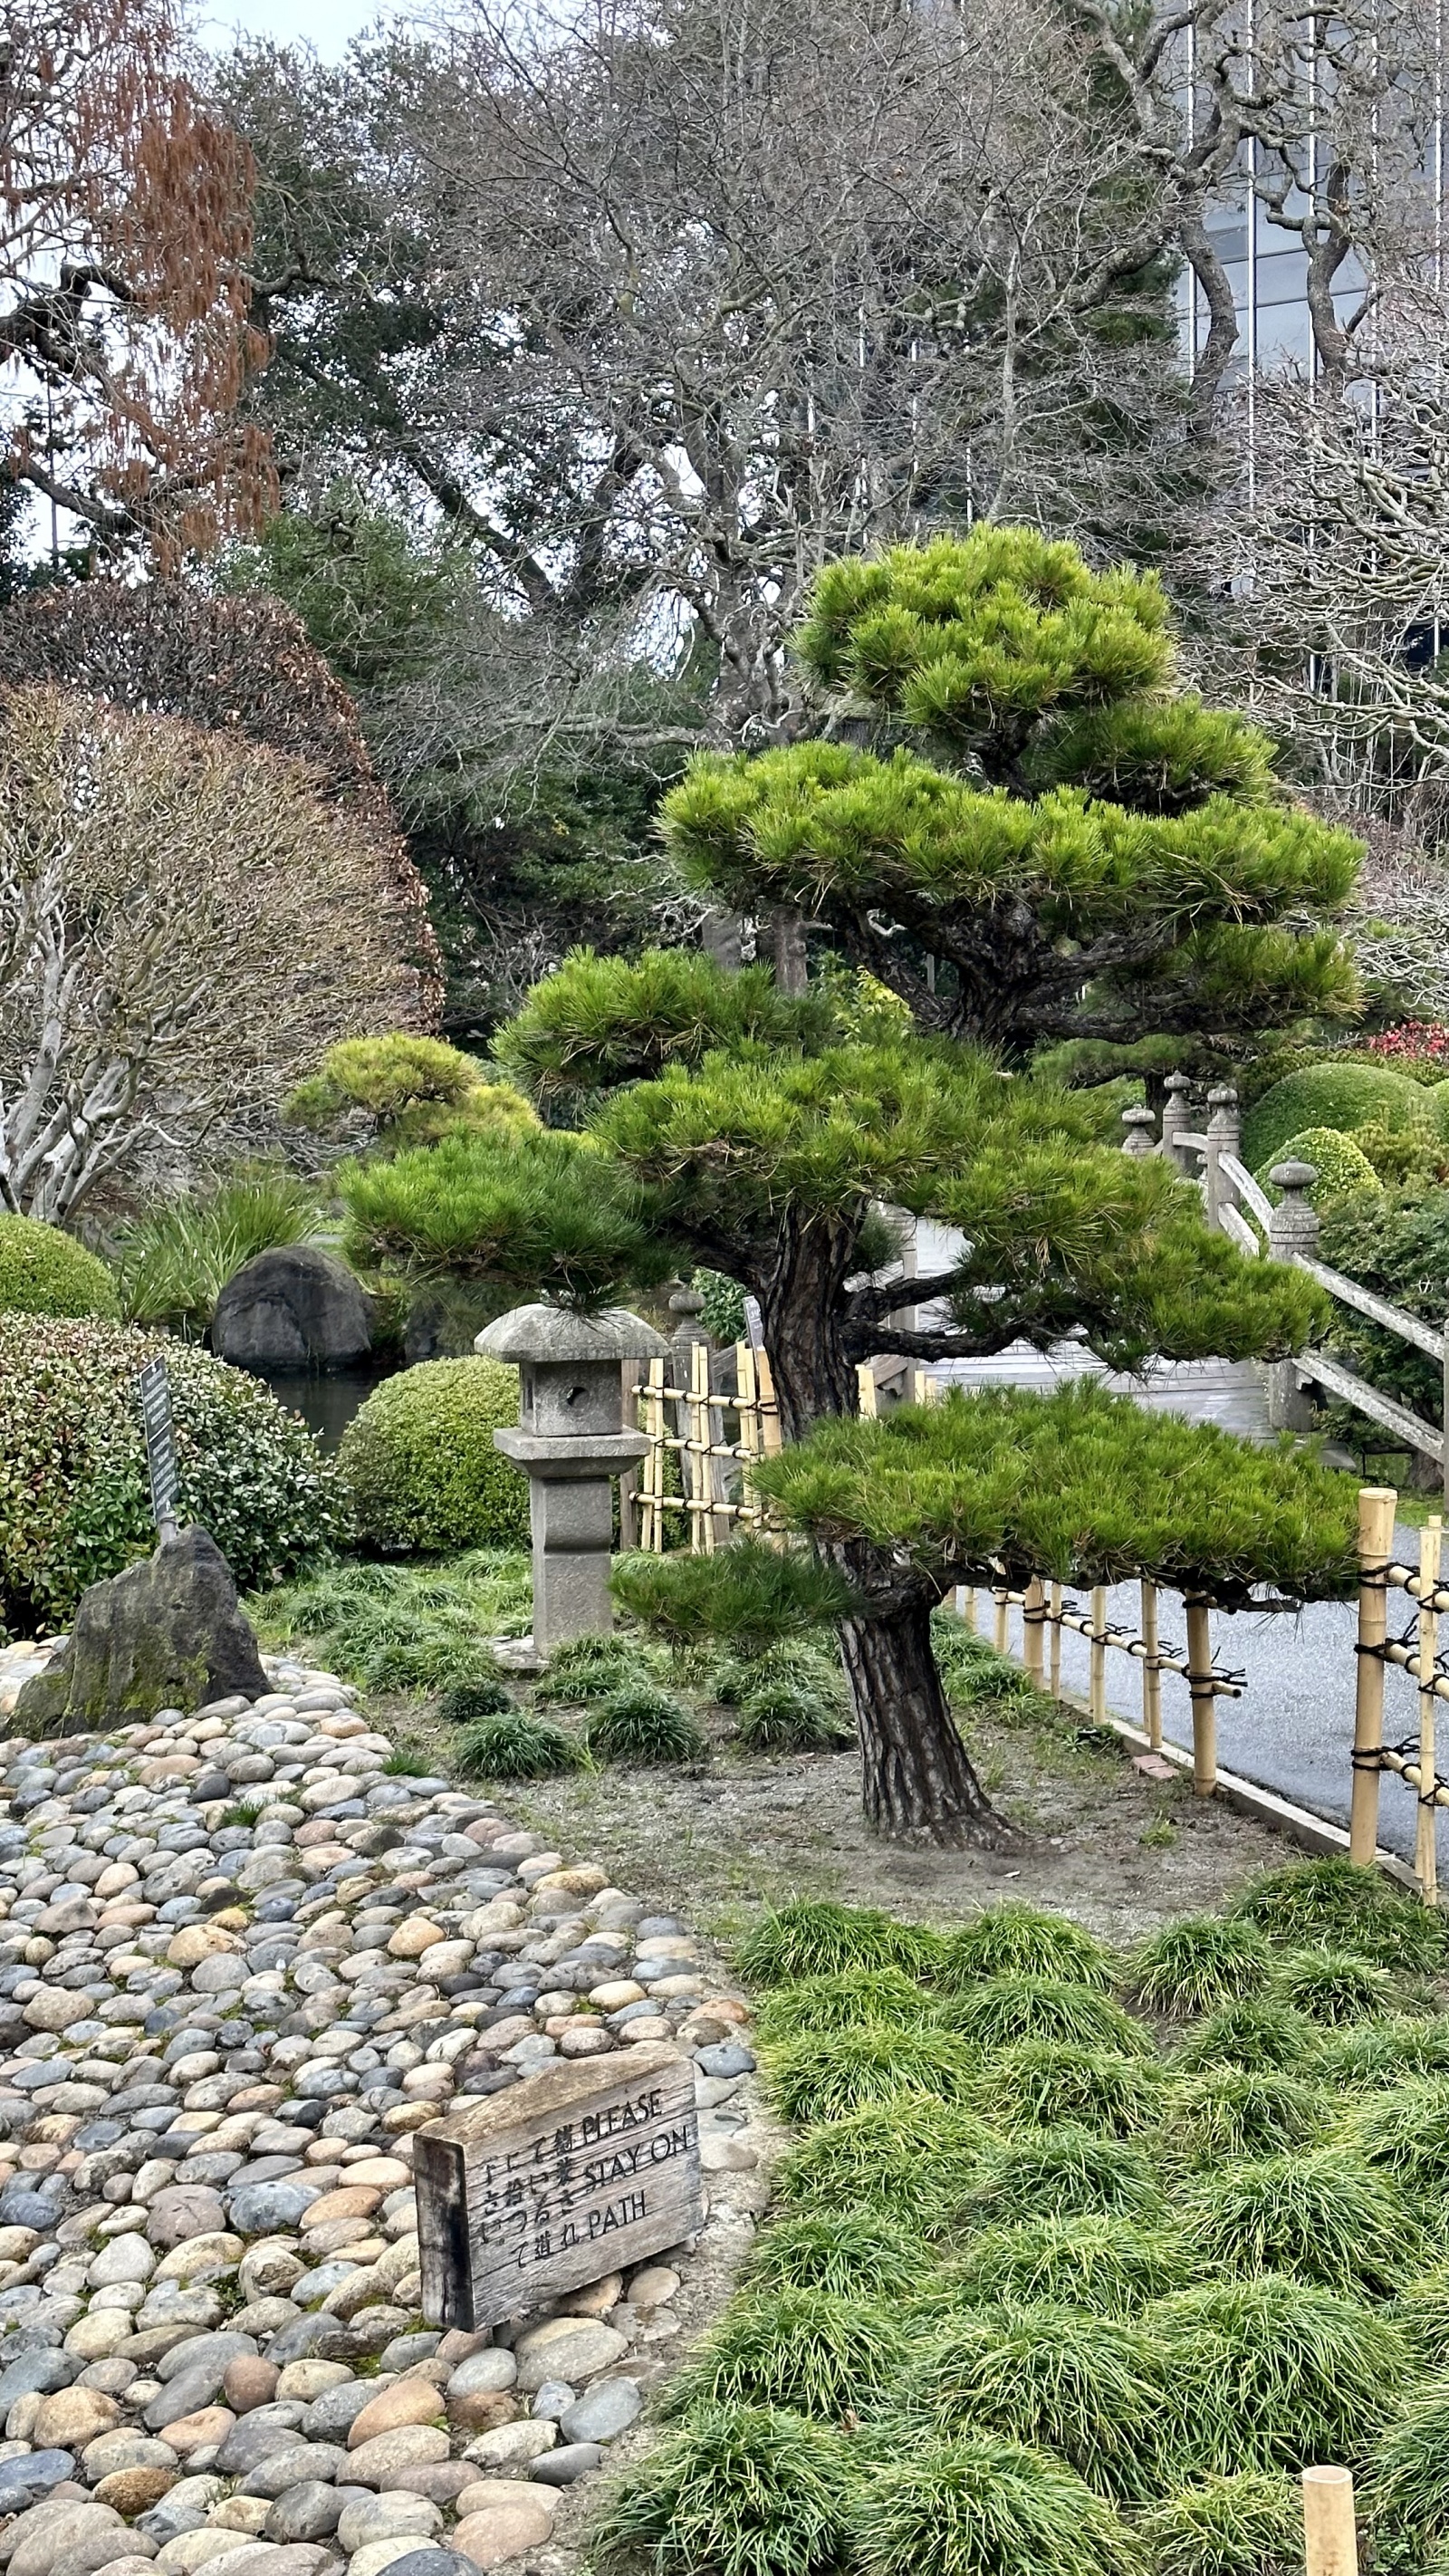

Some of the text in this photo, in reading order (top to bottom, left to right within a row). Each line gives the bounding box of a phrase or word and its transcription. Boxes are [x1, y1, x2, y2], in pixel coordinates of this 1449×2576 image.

[582, 2089, 662, 2144] PLEASE
[586, 2126, 688, 2192] STAY ON
[589, 2190, 645, 2239] PATH
